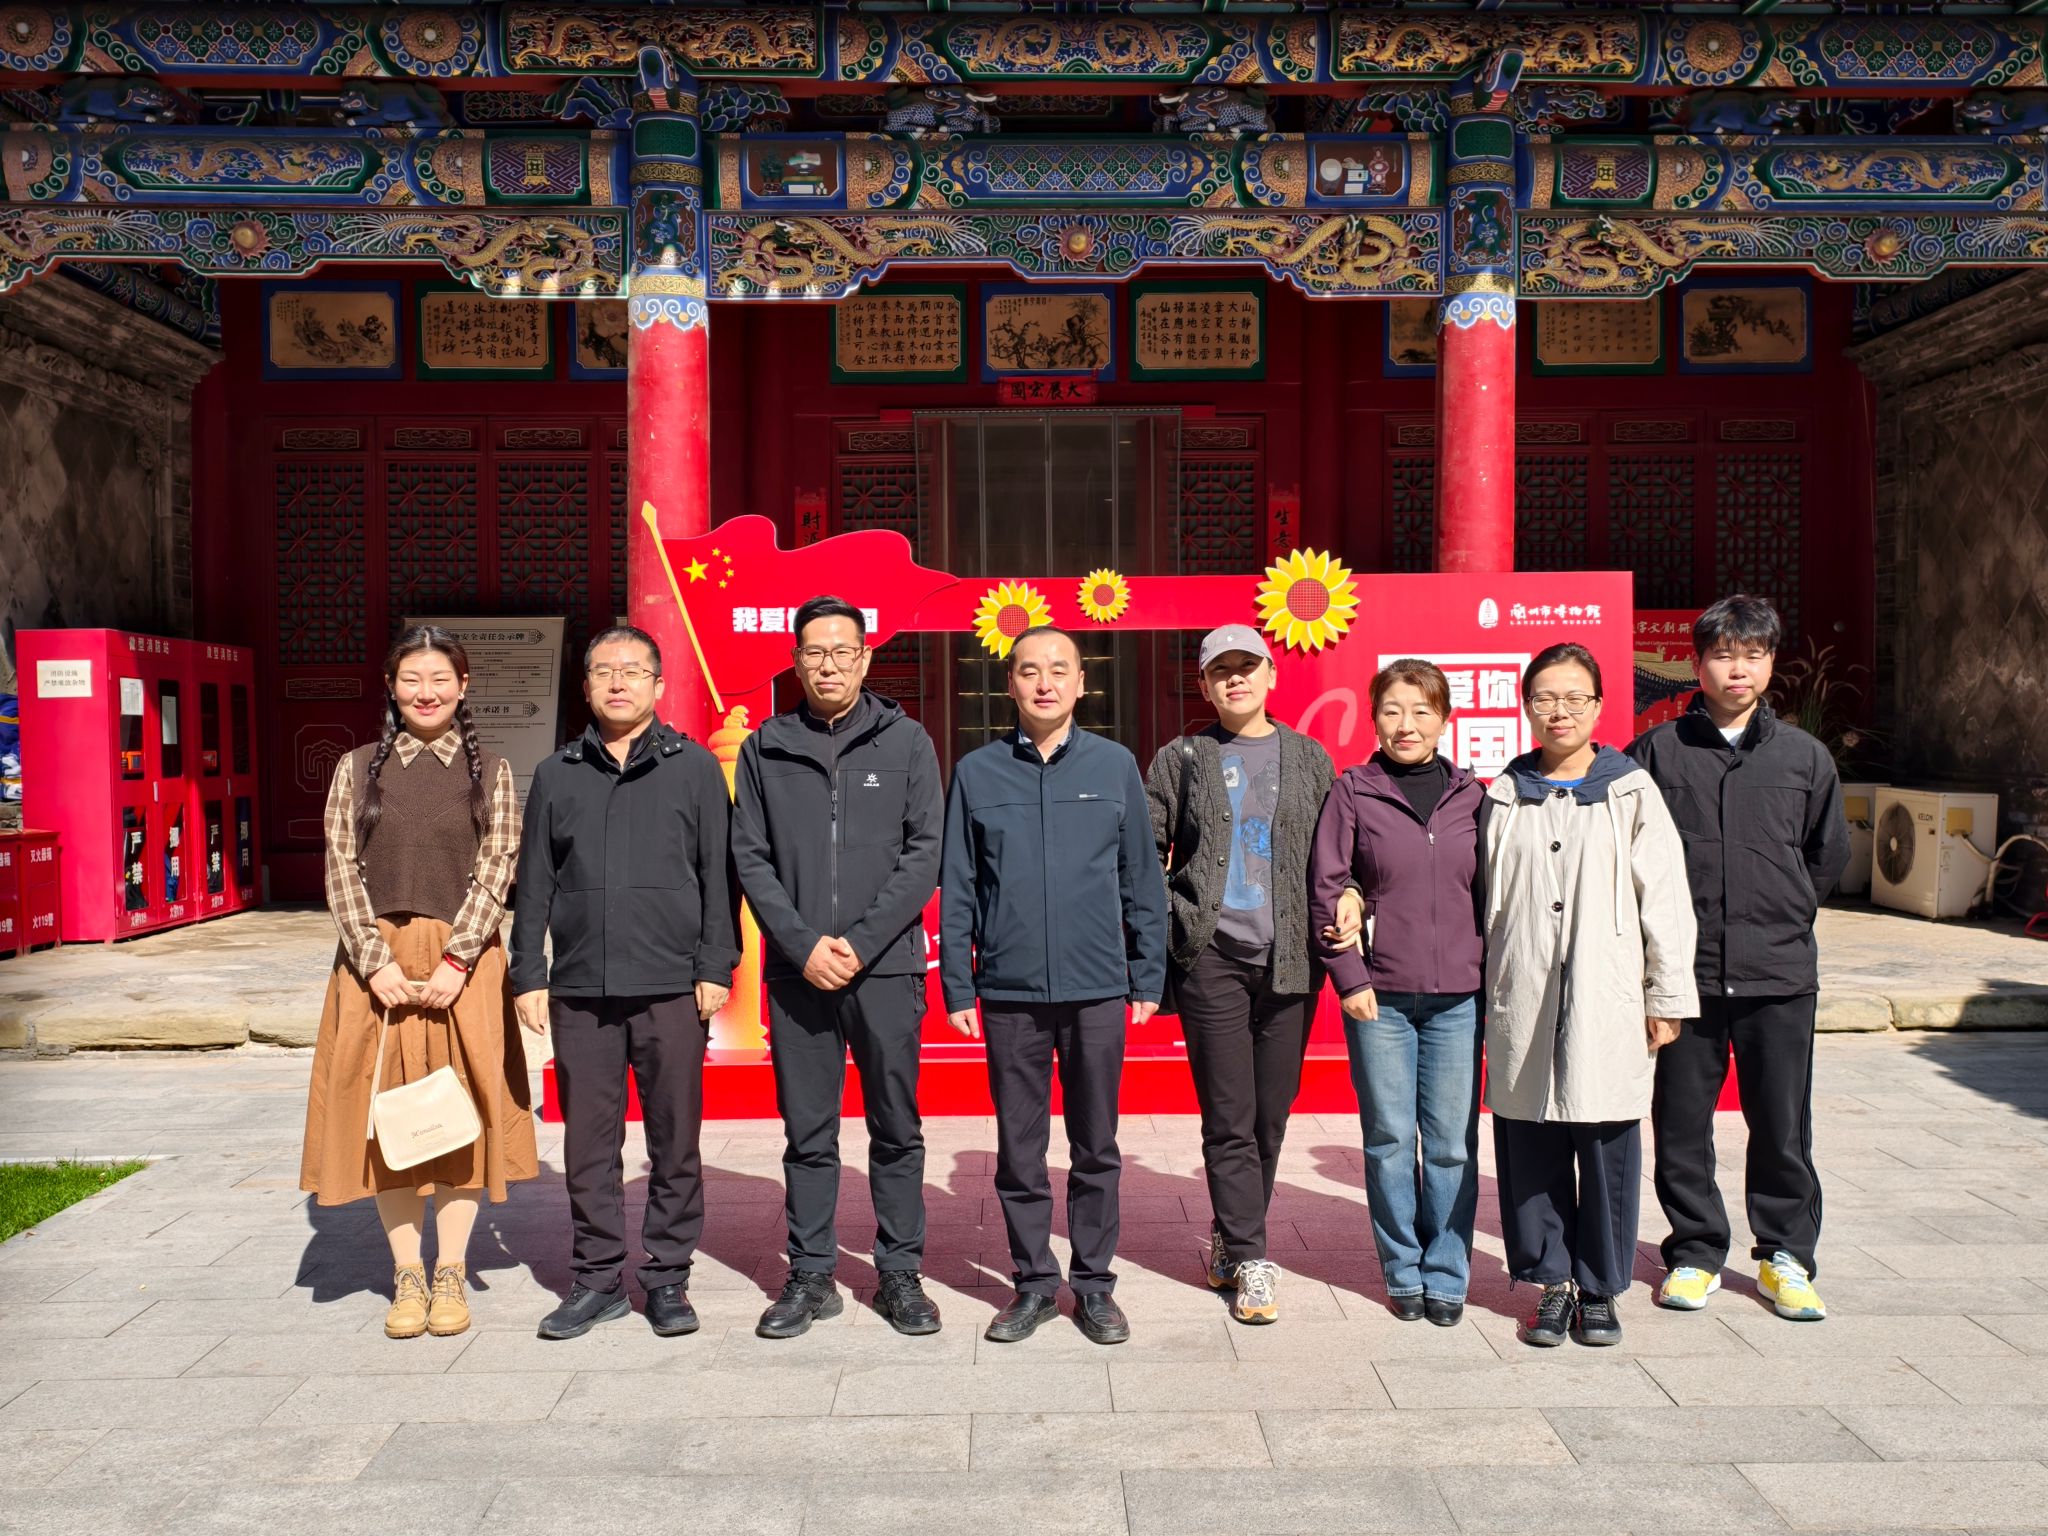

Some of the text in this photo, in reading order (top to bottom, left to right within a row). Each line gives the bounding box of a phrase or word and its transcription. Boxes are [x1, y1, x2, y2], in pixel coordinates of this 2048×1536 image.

[30, 847, 52, 863] 灭火器箱
[130, 831, 143, 885] 严禁
